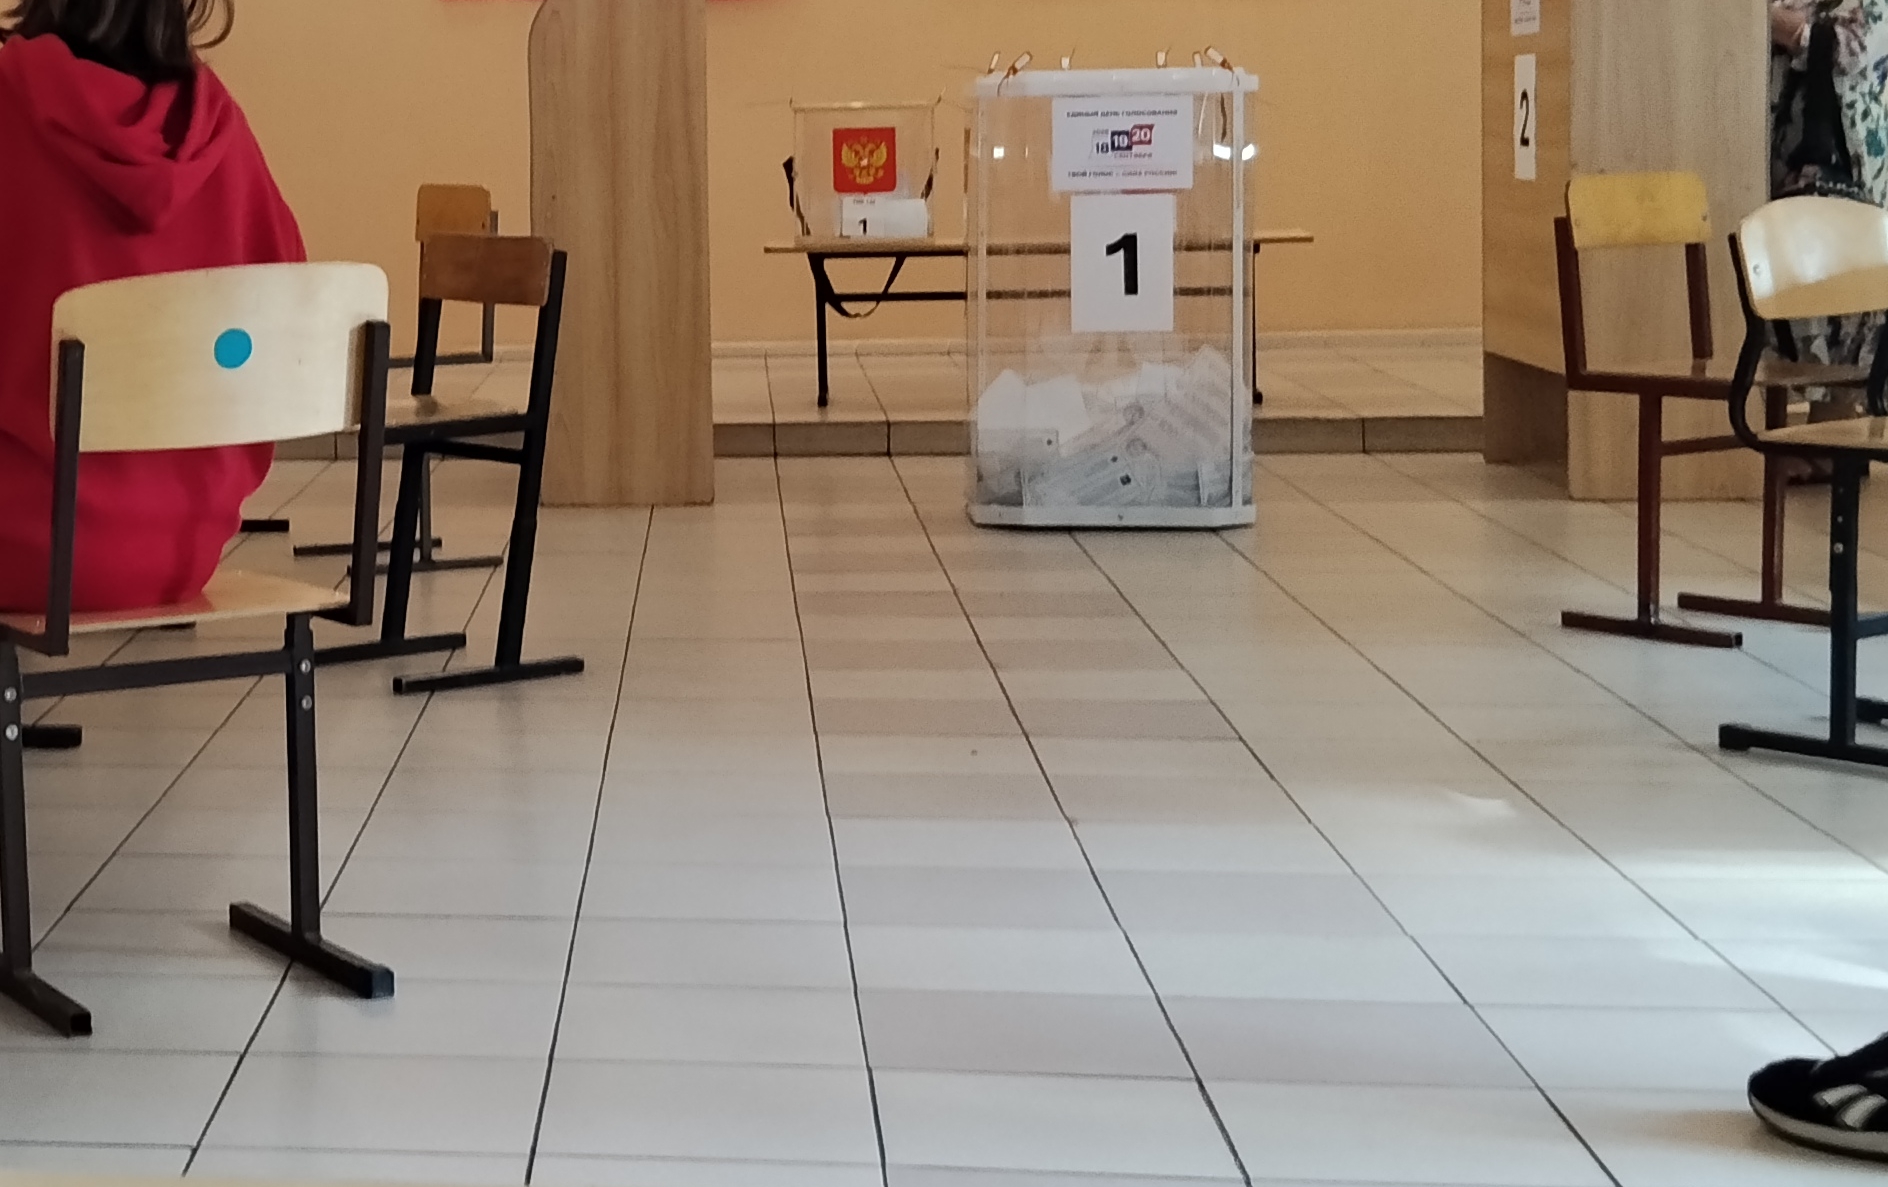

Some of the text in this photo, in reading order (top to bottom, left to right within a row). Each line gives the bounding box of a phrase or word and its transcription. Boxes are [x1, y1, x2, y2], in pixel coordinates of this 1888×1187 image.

[1132, 127, 1151, 143] 20
[1519, 88, 1530, 147] 2
[857, 217, 868, 235] 1
[1105, 232, 1140, 296] 1
